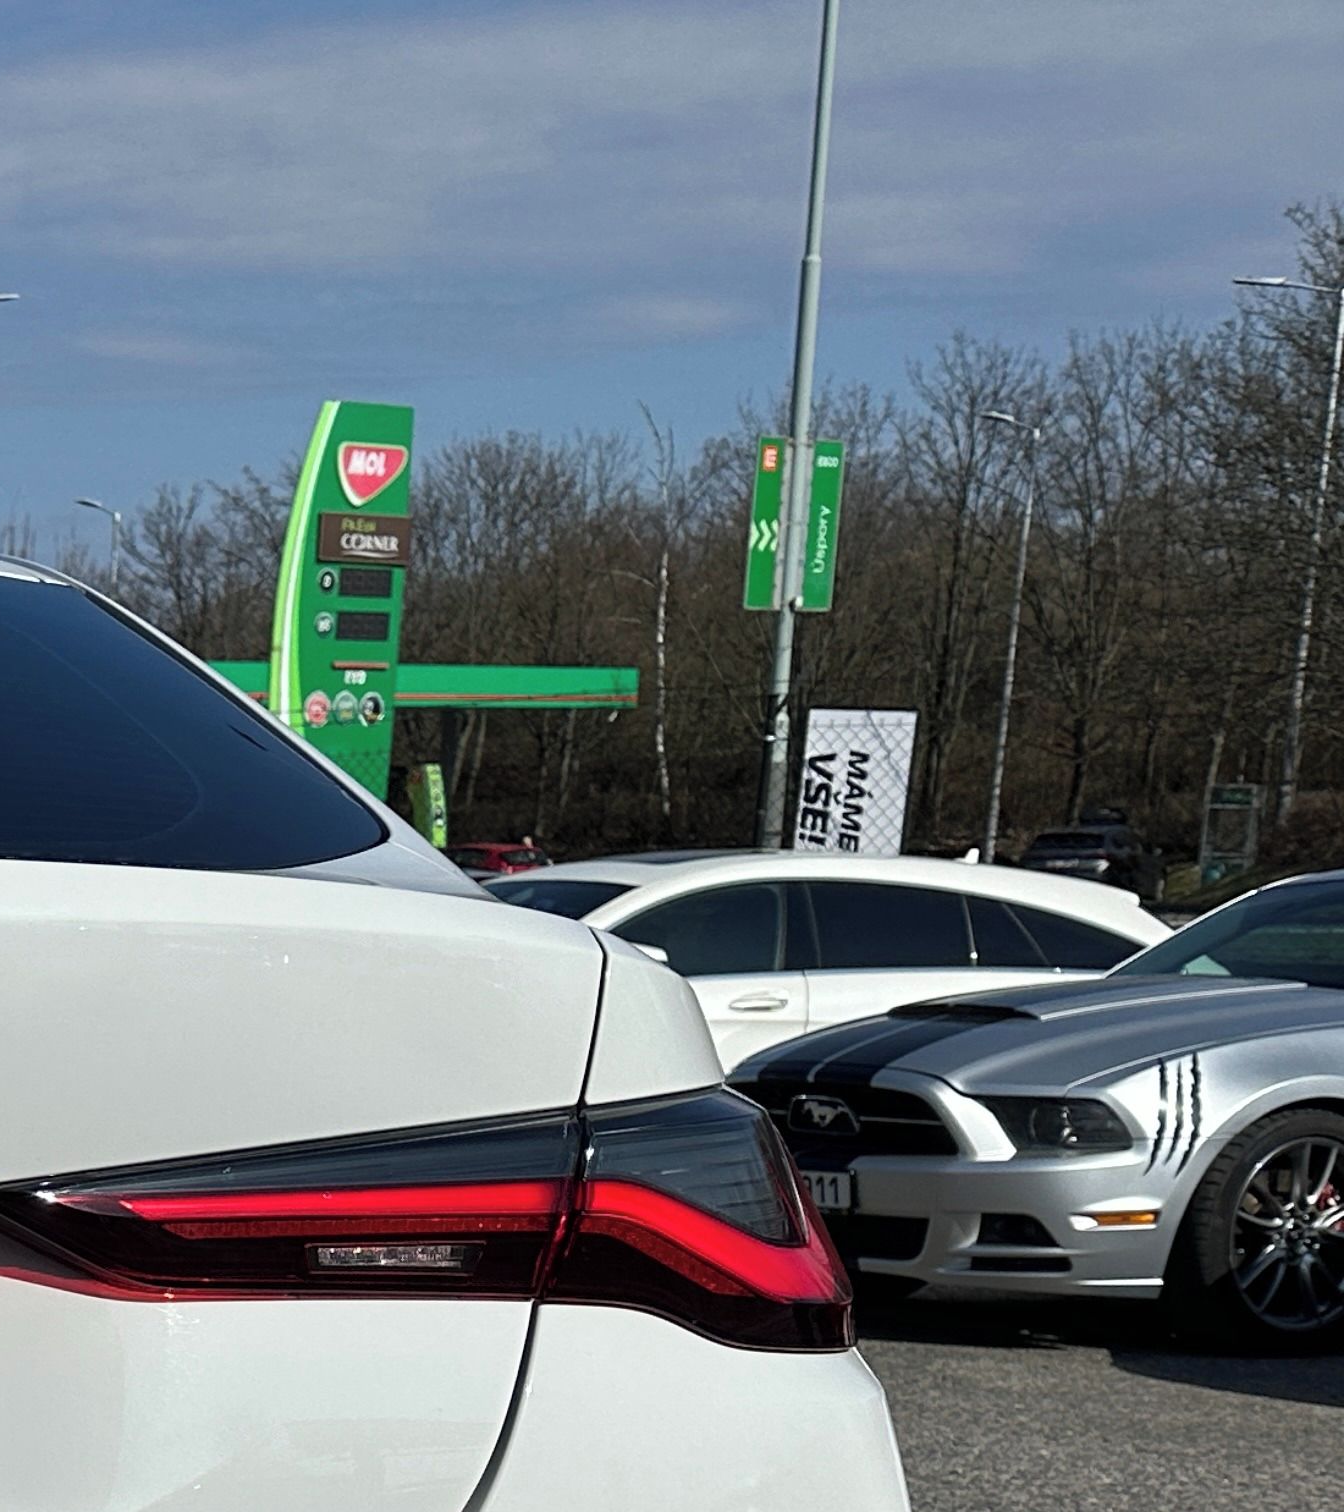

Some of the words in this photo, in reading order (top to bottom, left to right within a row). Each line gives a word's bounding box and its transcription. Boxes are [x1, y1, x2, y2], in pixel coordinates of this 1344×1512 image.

[348, 449, 387, 477] MOL
[799, 753, 841, 845] VŠE!
[838, 751, 873, 852] MÁME
